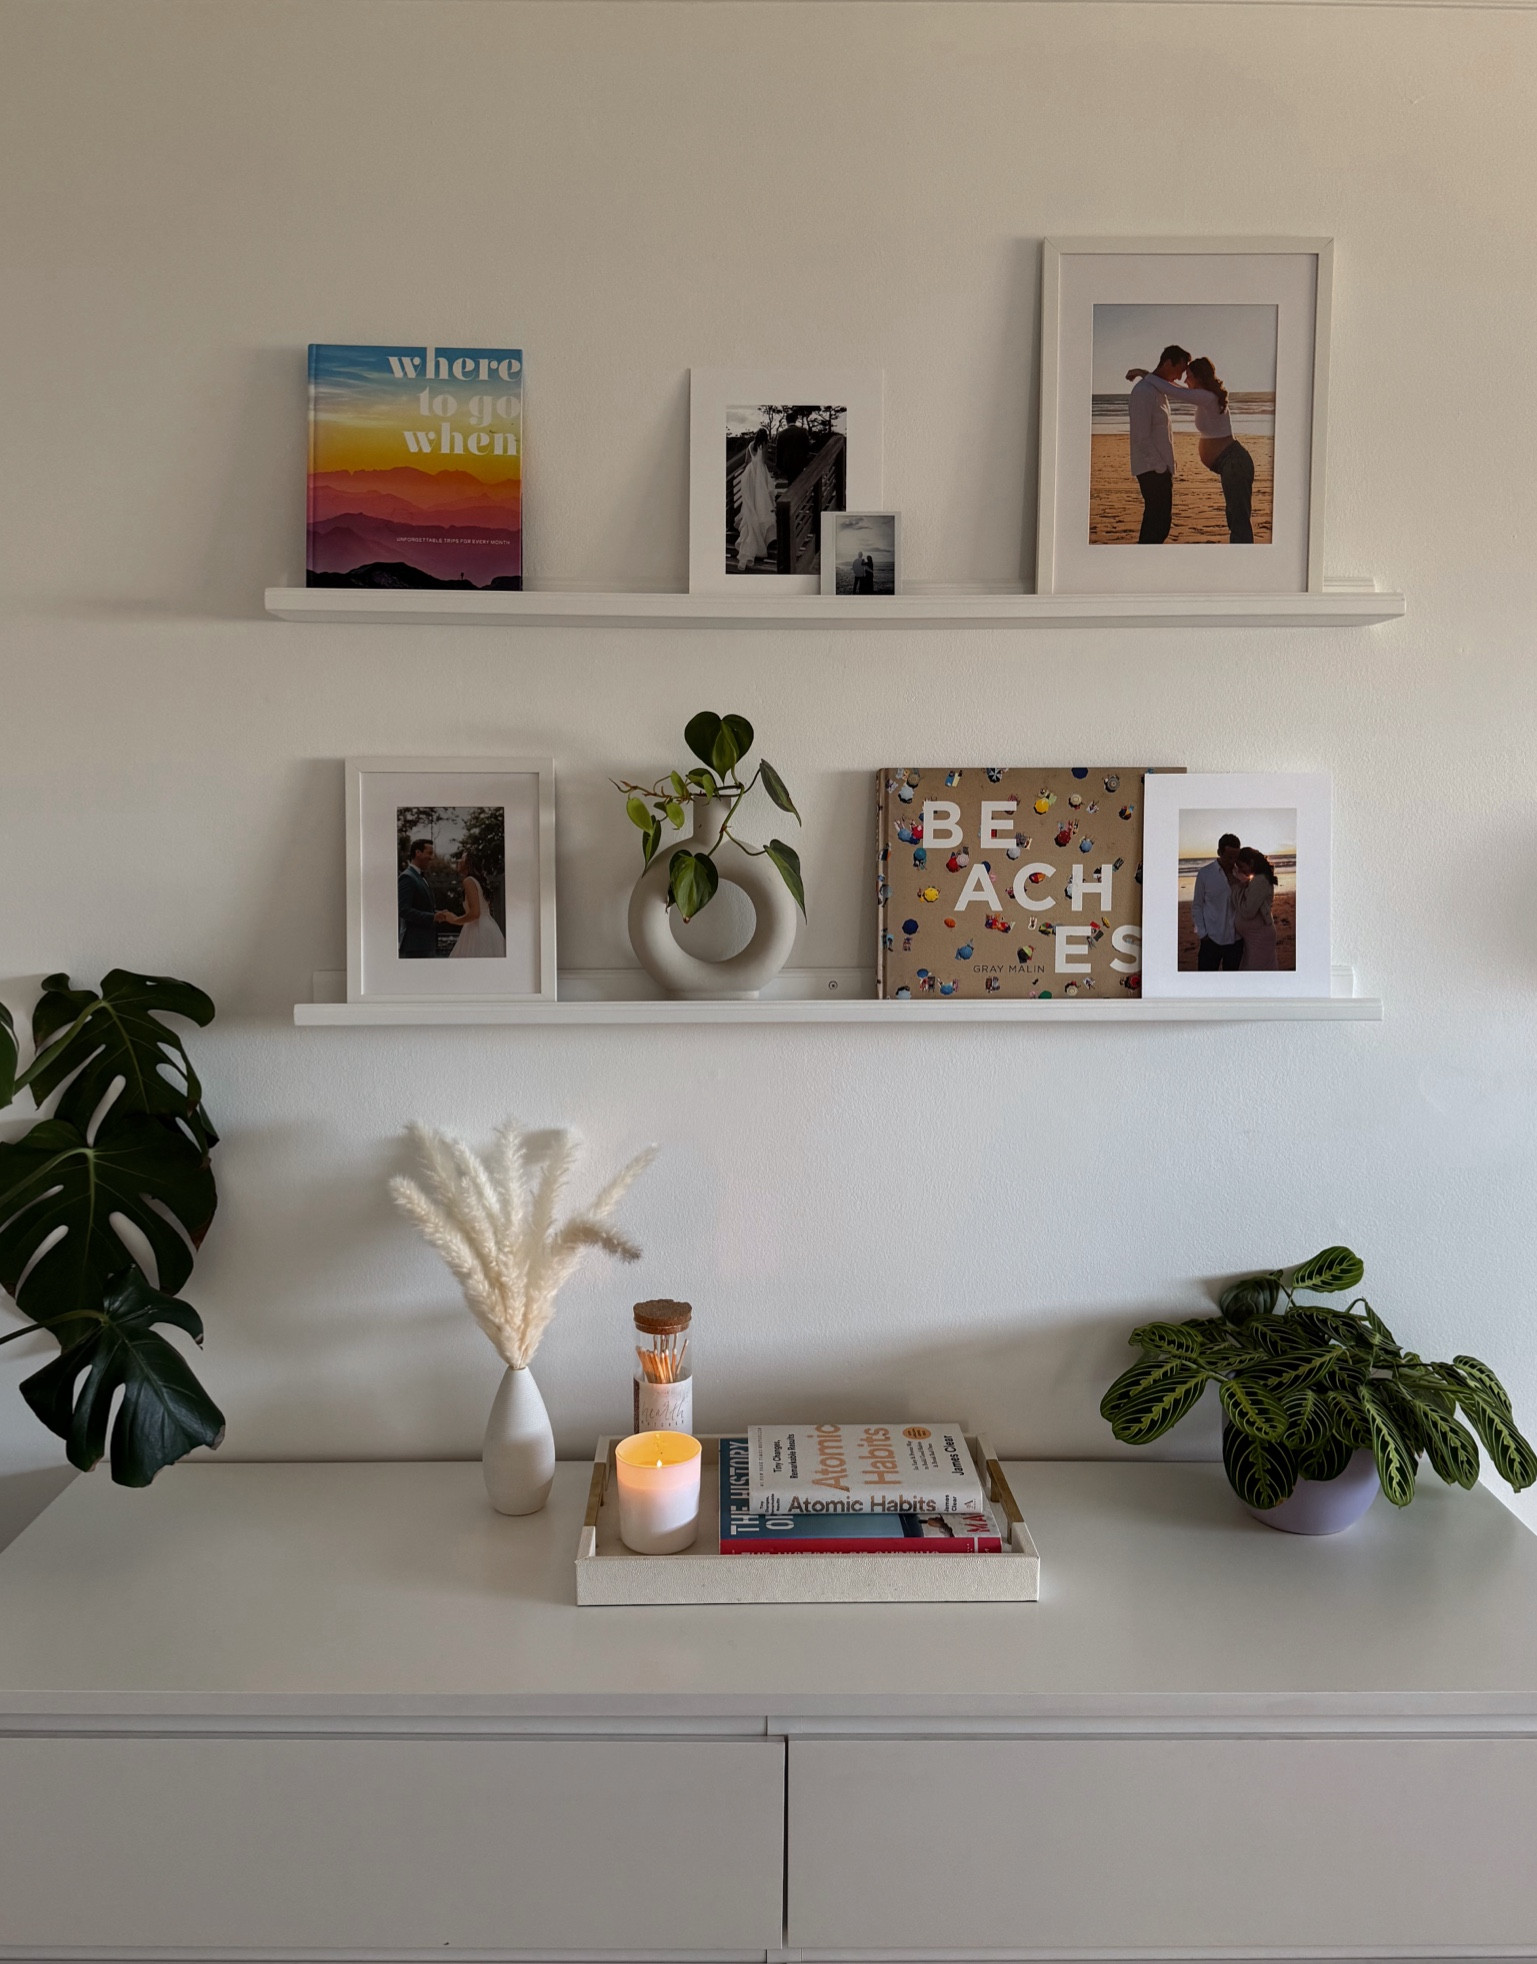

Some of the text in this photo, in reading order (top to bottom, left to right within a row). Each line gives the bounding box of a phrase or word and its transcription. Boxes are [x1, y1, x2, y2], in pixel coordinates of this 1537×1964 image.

[386, 347, 521, 381] where
[417, 386, 521, 428] to go
[403, 422, 519, 456] when
[922, 801, 1018, 849] BE
[954, 863, 1113, 912] ACH
[973, 965, 1045, 973] GRAY MALIN
[772, 1440, 784, 1473] Tiny Changes,
[787, 1433, 798, 1479] Remarkable Results
[807, 1424, 850, 1492] Atomic
[857, 1427, 902, 1485] Habits
[943, 1435, 965, 1475] James Clear
[729, 1441, 759, 1535] THE HISTORY
[788, 1495, 937, 1513] Atomic Habits
